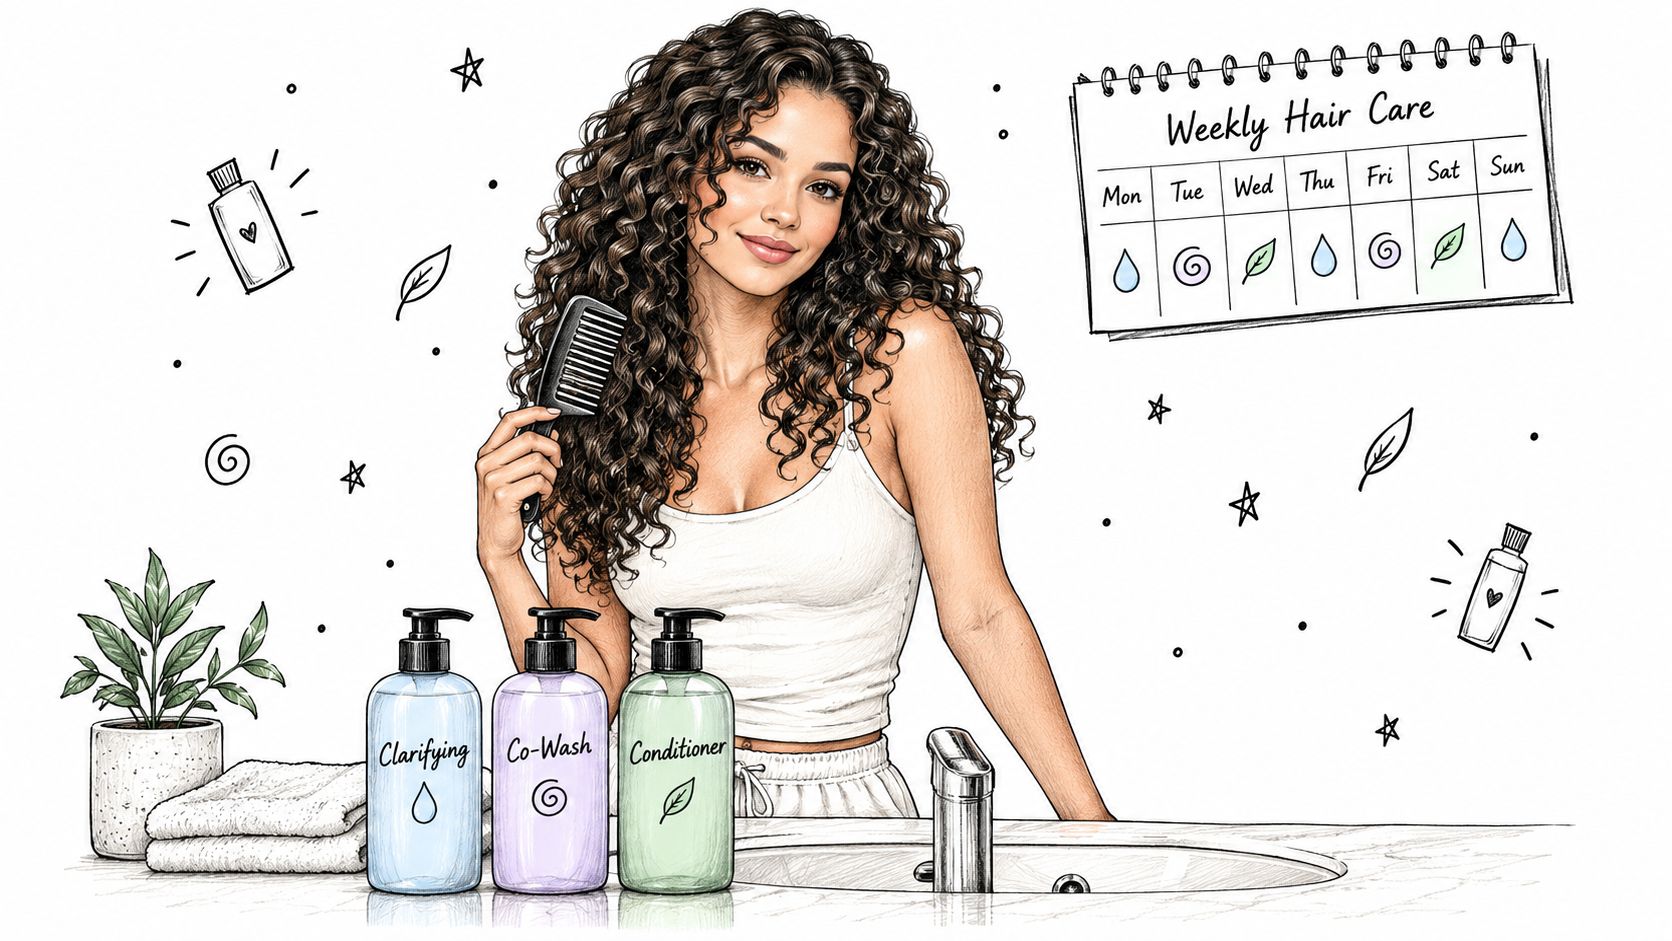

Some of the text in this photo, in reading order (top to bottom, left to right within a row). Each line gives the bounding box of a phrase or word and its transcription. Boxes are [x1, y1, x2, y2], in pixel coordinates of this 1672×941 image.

[1168, 91, 1435, 152] Weekly Hair Care
[1102, 155, 1525, 208] Mon Tue Wed Thu Fri Sat Sun
[379, 737, 471, 771] Clarifying
[506, 731, 593, 763] Co-Wash
[629, 736, 728, 766] Conditioner
